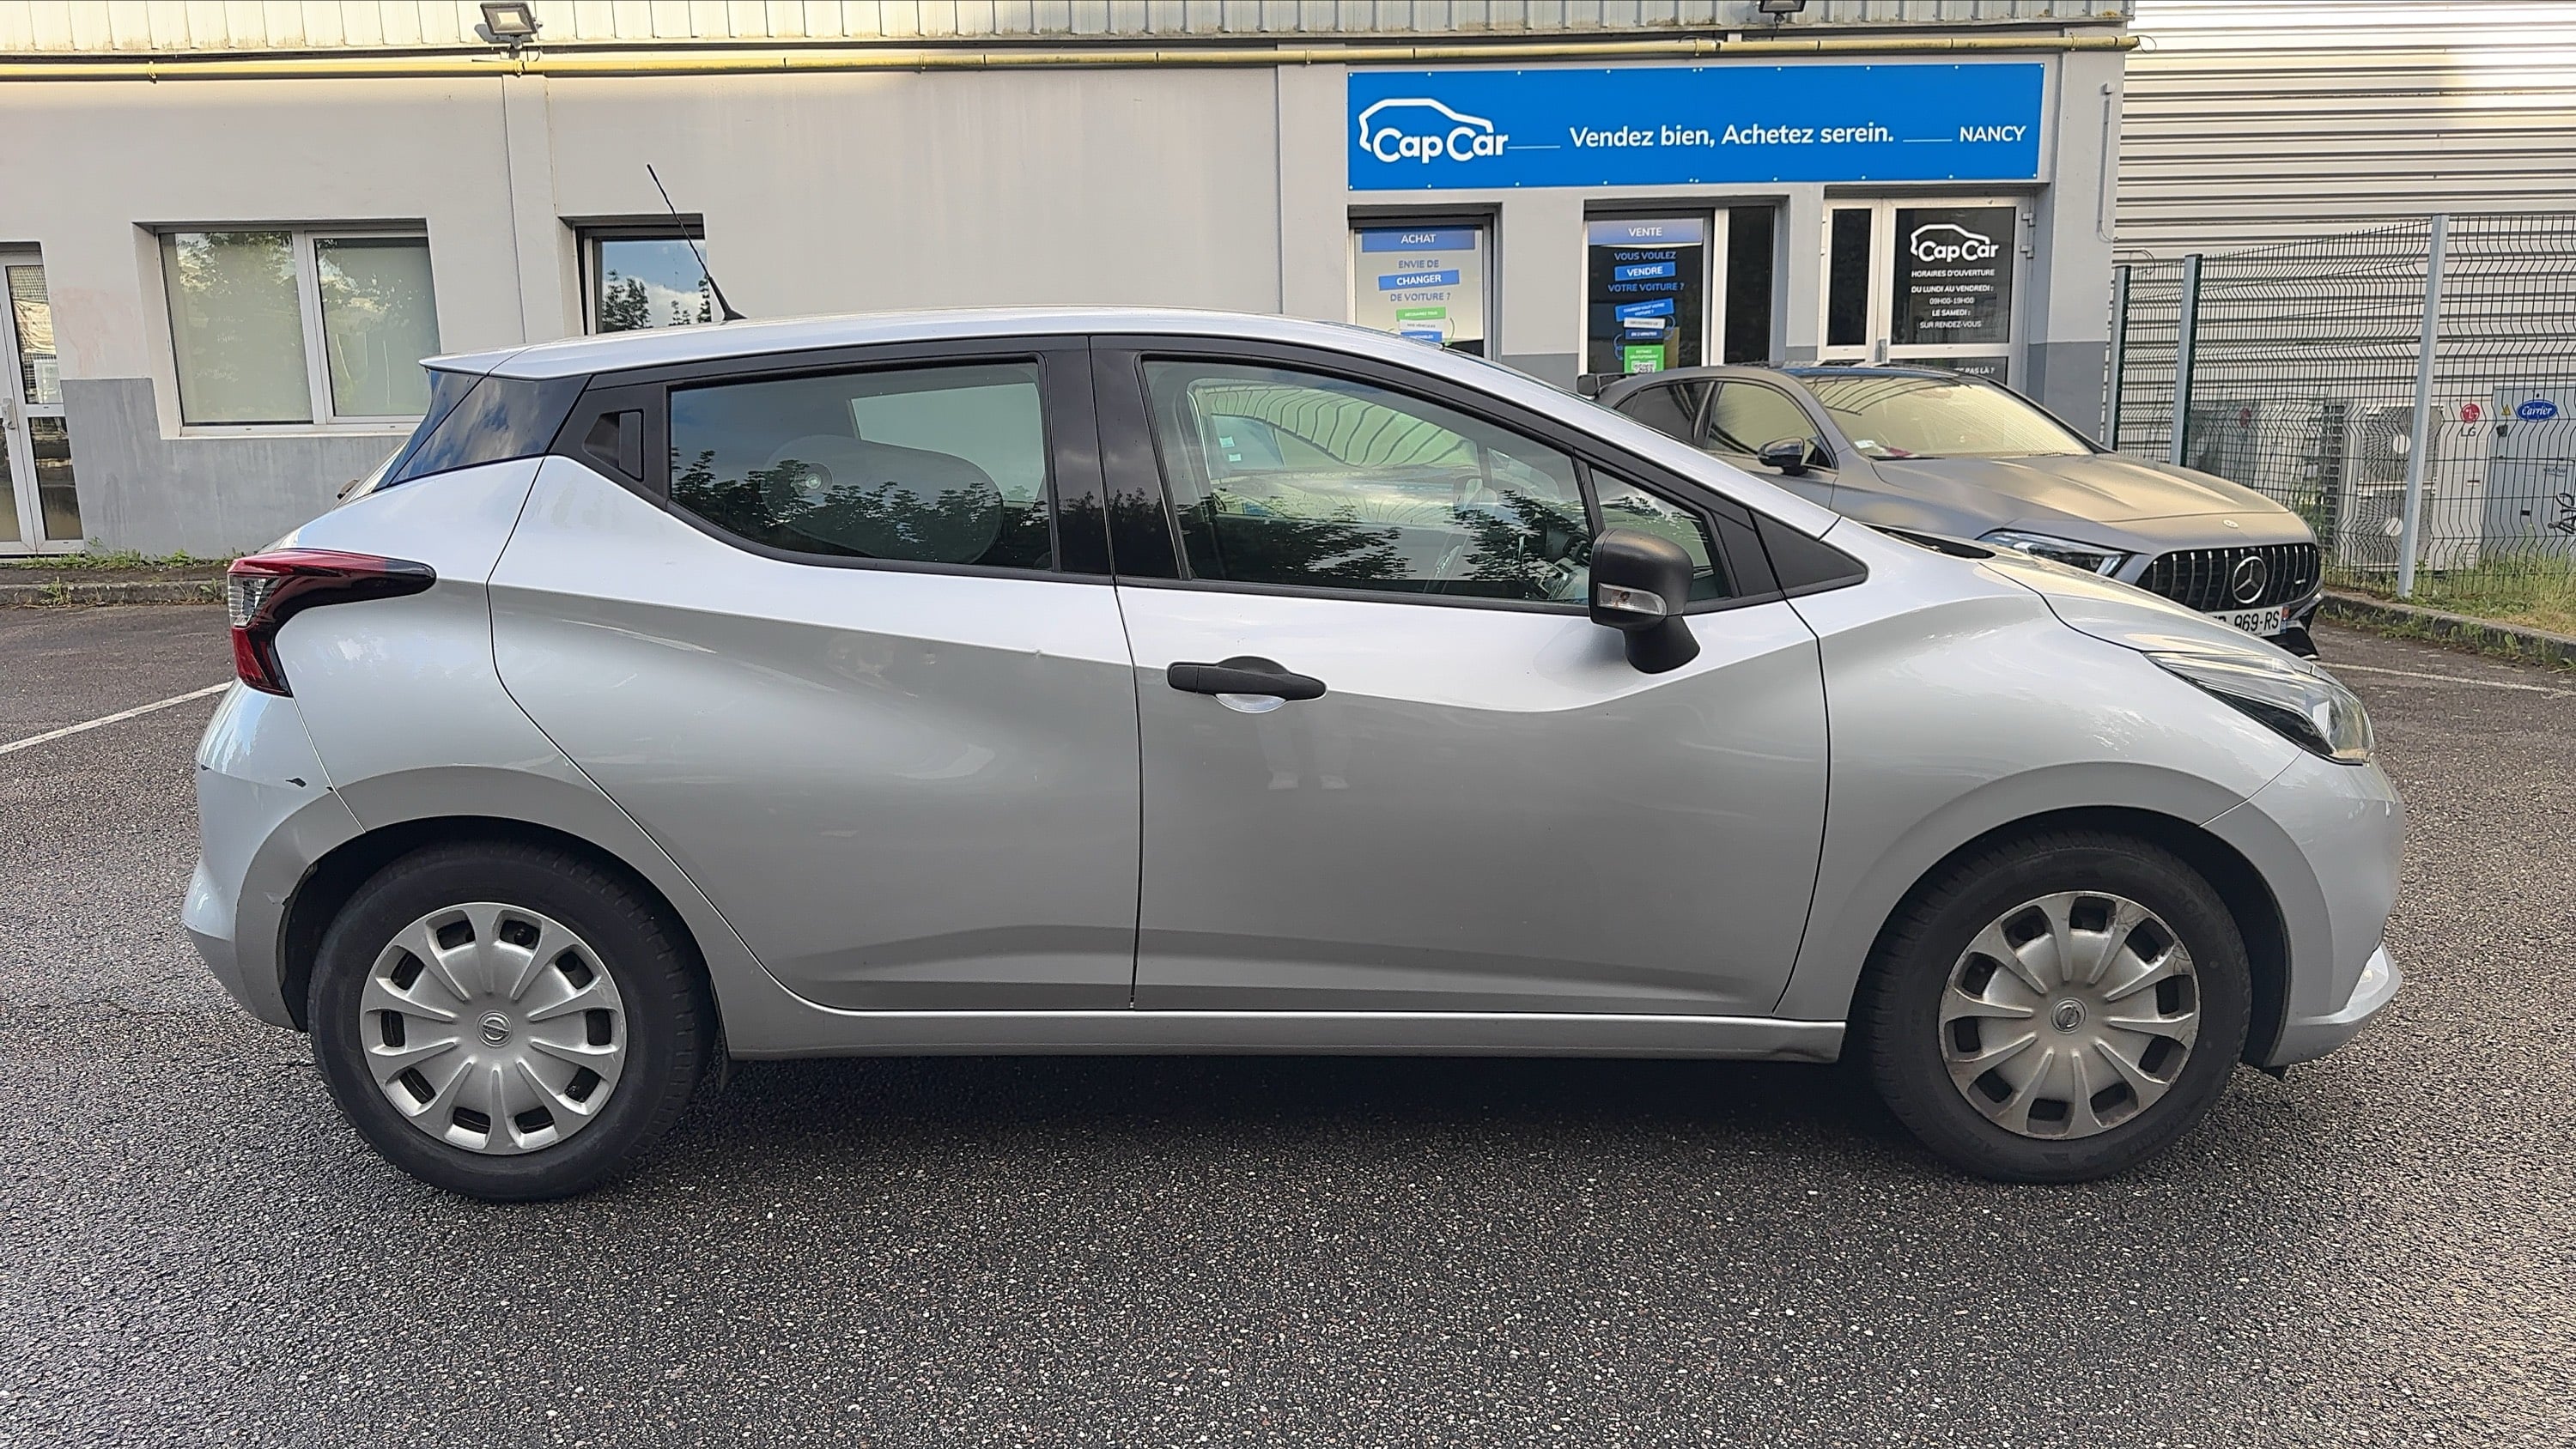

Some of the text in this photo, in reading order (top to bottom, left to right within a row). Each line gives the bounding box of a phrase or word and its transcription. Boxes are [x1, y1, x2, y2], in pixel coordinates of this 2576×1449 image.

[1570, 122, 1894, 149] Vendez bien, Achetez serein.
[1959, 125, 2026, 142] NANCY
[1628, 227, 1662, 237] VENTE
[1400, 233, 1436, 244] ACHAT
[1614, 251, 1676, 261] VOUS VOULEZ
[1398, 259, 1440, 269] ENVIE DE
[1626, 265, 1663, 276] VENDRE
[1911, 270, 1947, 278] HORAIRES
[1396, 274, 1442, 286] CHANGER
[1607, 282, 1686, 293] VOTRE VOITURE ?
[1390, 292, 1451, 302] DE VOITURE ?
[2521, 404, 2553, 416] Carrier
[2460, 427, 2476, 437] LG
